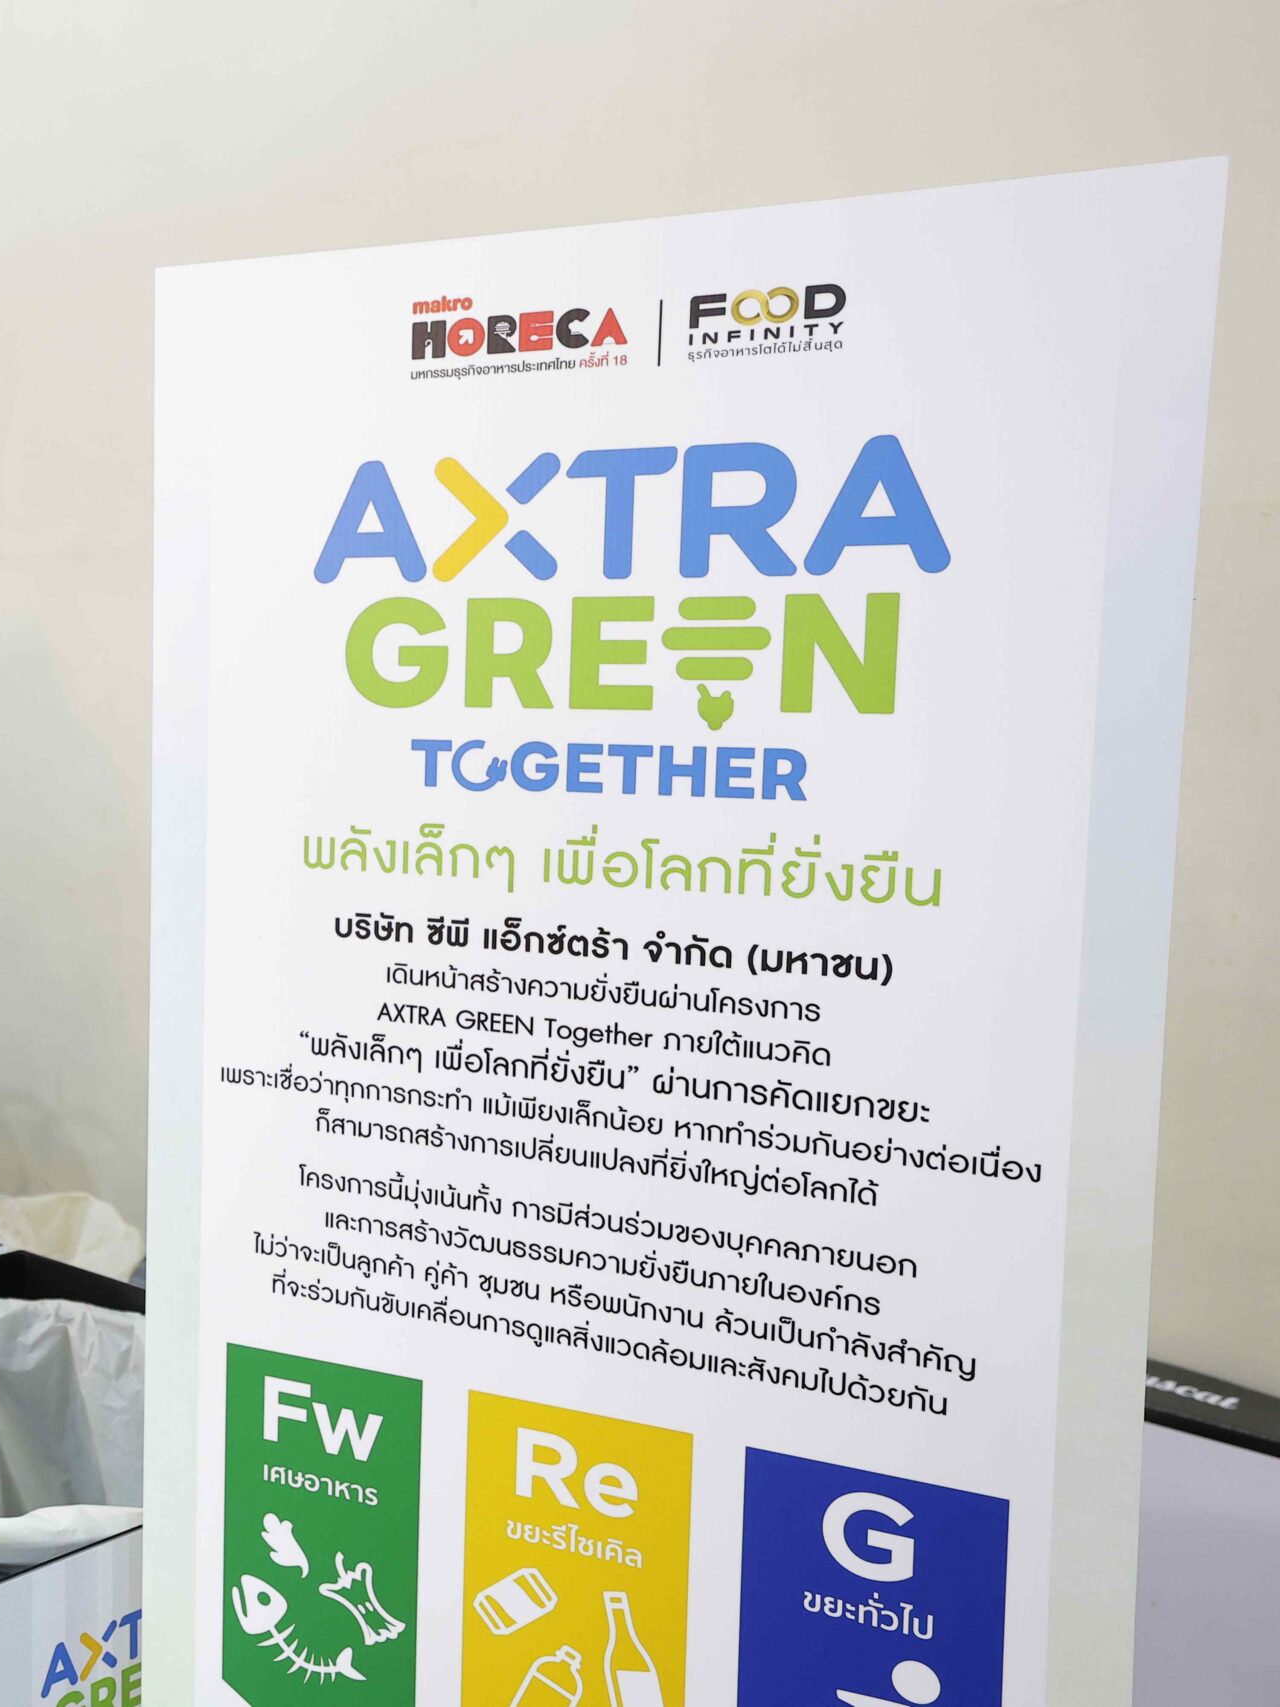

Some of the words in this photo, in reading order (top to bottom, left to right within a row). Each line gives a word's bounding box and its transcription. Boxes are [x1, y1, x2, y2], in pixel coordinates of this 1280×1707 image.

[411, 307, 629, 361] HORECA
[412, 295, 473, 315] makro
[688, 284, 848, 329] FOOD
[688, 320, 845, 347] INFINITY
[410, 356, 577, 381] มหกรรมธุรกิจอาหารประเทศไทย
[579, 350, 610, 370] ครั้งที่
[613, 354, 629, 367] 18
[687, 338, 844, 362] ธุรกิจอาหารโตได้ไม่สิ้นสุด
[314, 434, 952, 584] AXTRA
[345, 592, 901, 731] GREEN
[411, 738, 807, 801] TOGETHER
[302, 822, 516, 894] พลังเล็กๆ
[542, 824, 943, 907] เพื่อโลกที่ยั่งยืน
[333, 910, 414, 944] บริษัท
[426, 914, 470, 948] ซีพี
[483, 917, 629, 960] แอ็กซ์ตร้า
[643, 933, 734, 971] จำกัด
[747, 943, 894, 987] (มหาชน)
[385, 962, 821, 1023] เดินหน้าสร้างความยั่งยืนผ่านโครงการ
[377, 1002, 446, 1028] AXTRA
[455, 1009, 534, 1037] GREEN
[544, 1017, 653, 1051] Together
[663, 1029, 832, 1068] ภายใต้แนวคิด
[220, 1063, 473, 1113] เพราะเชื่อว่าทุกการกระทำ
[483, 1092, 663, 1136] แม้เพียงเล็กน้อย
[674, 1117, 1042, 1183] หากทำร่วมกันอย่างต่อเนื่อง
[653, 1066, 931, 1123] ผ่านการคัดแยกขยะ
[315, 1106, 879, 1207] ก็สามารถสร้างการเปลี่ยนแปลงที่ยิ่งใหญ่ต่อโลกได้
[298, 1163, 503, 1215] โครงการนี้มุ่งเน้นทั้ง
[512, 1199, 918, 1279] การมีส่วนร่วมของบุคคลภายนอก
[324, 1210, 881, 1316] และการสร้างวัฒนธรรมความยั่งยืนภายในองค์กร
[253, 1231, 415, 1280] ไม่ว่าจะเป็นลูกค้า
[424, 1261, 469, 1290] คู่ค้า
[478, 1271, 541, 1300] ชุมชน
[550, 1283, 704, 1329] หรือพนักงาน
[715, 1307, 977, 1382] ล้วนเป็นกำลังสำคัญ
[271, 1268, 949, 1416] ที่จะร่วมกันขับเคลื่อนการดูแลสิ่งแวดล้อมและสังคมไปด้วยกัน
[262, 1375, 384, 1463] Fw
[262, 1461, 380, 1507] เศษอาหาร
[514, 1426, 640, 1518] Re
[505, 1517, 645, 1570] ขยะรีไซเคิล
[821, 1490, 916, 1583] G
[41, 1608, 142, 1699] AXT
[802, 1588, 935, 1642] ขยะทั่วไป
